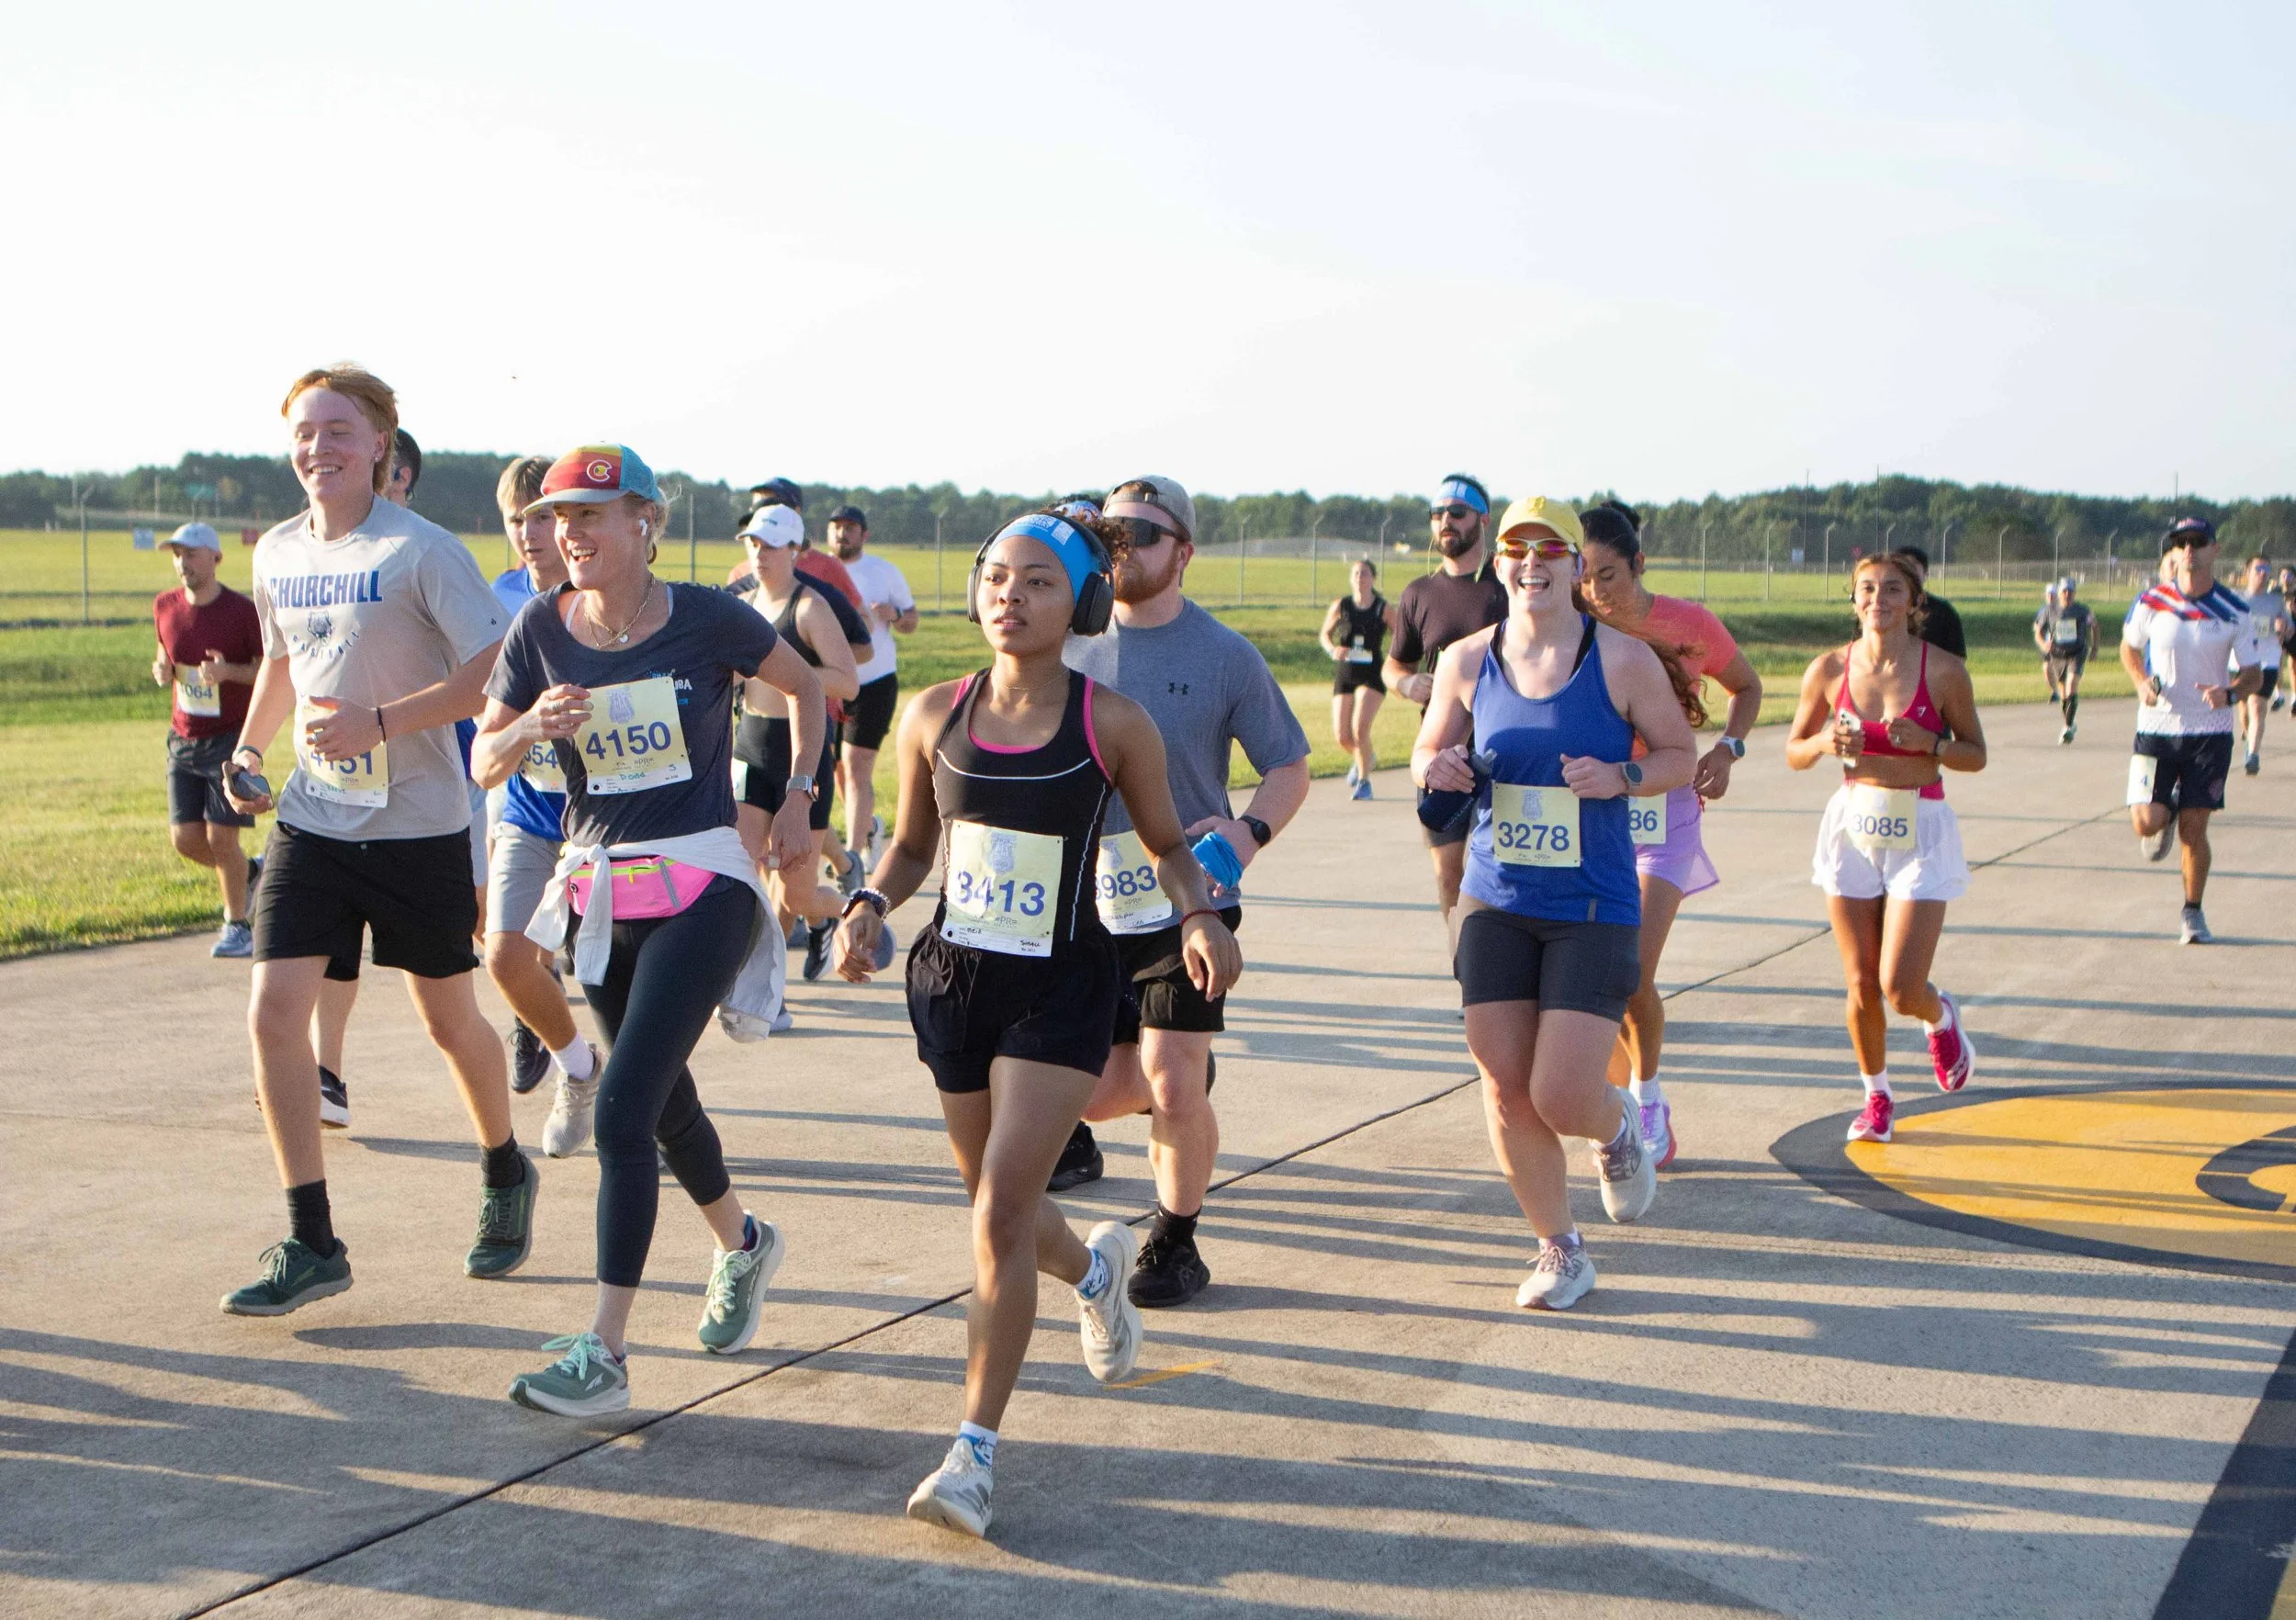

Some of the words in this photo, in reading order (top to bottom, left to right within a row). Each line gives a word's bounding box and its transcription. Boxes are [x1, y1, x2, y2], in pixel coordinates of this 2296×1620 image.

[269, 569, 383, 609] CHURCHILL
[585, 721, 672, 760] 4150
[1498, 821, 1570, 852] 3278
[1852, 814, 1908, 838] 3085
[955, 871, 1046, 917] 3413
